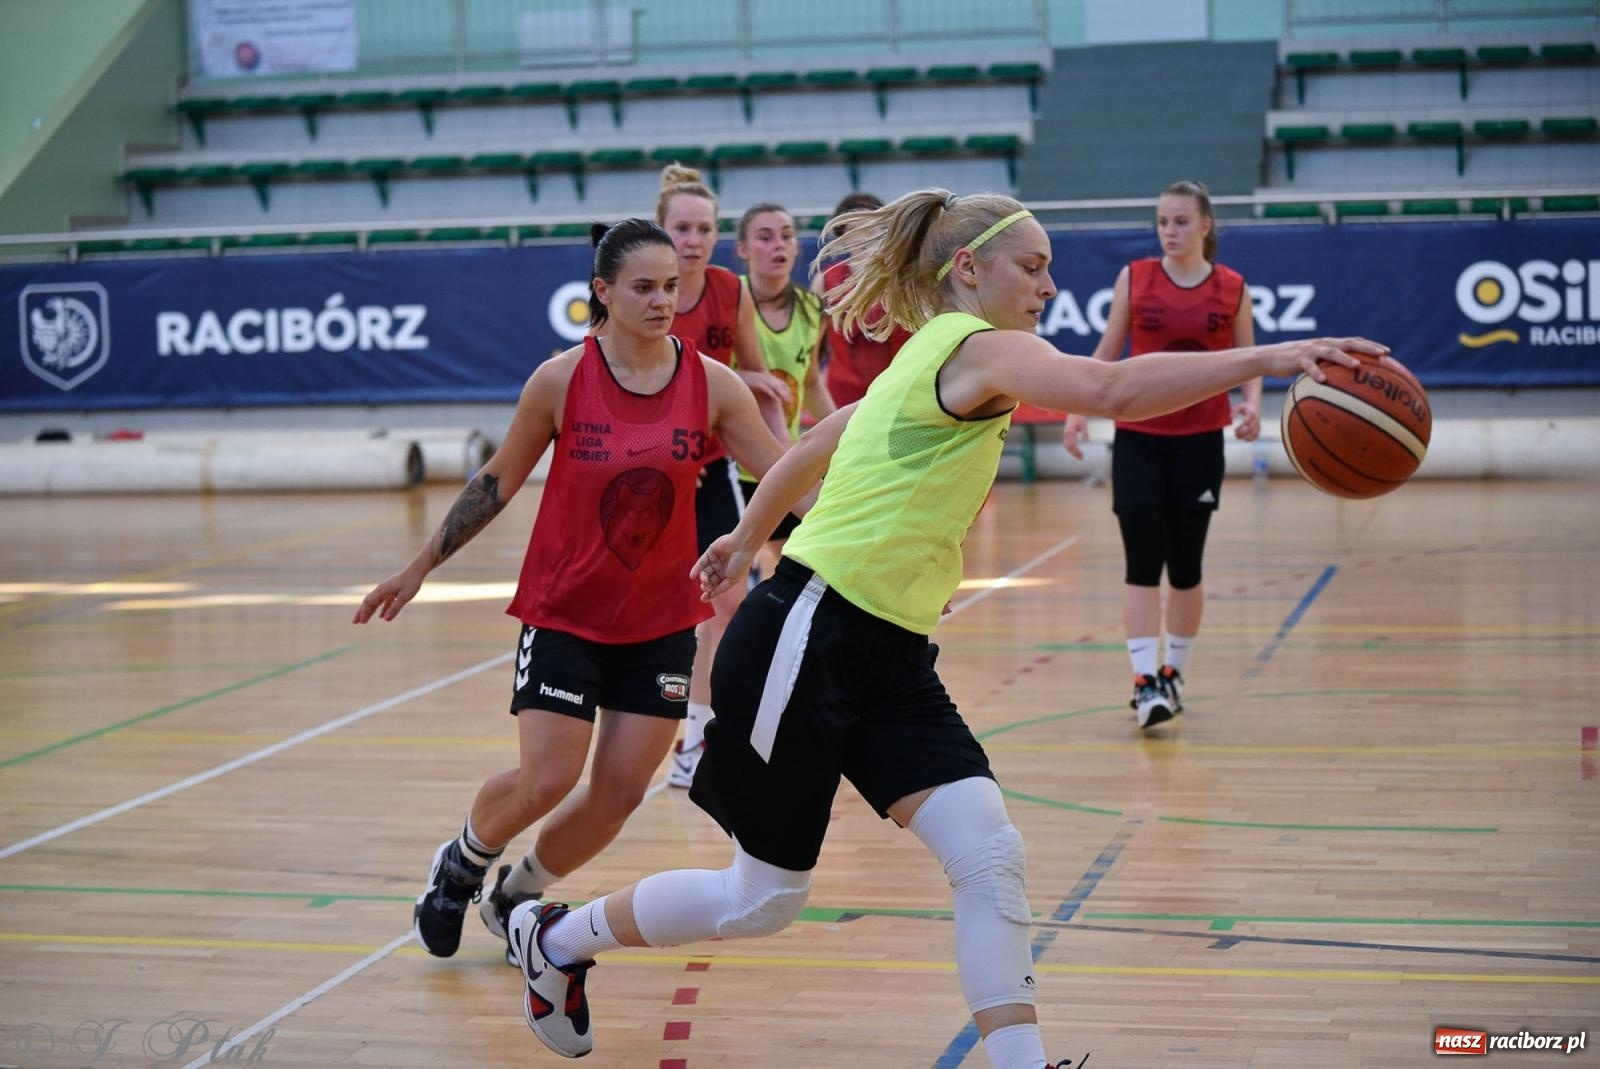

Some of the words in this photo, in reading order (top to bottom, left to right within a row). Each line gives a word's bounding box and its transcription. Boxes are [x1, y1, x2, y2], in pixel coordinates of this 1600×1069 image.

[1455, 258, 1600, 323] OSi
[156, 292, 429, 356] RACIBÓRZ
[1530, 325, 1600, 346] RACIB
[1353, 367, 1425, 422] molten
[571, 421, 612, 435] LETNIA
[576, 436, 603, 448] LIGA
[671, 428, 706, 462] 53
[569, 448, 611, 462] KOBIET
[539, 682, 584, 705] hummel
